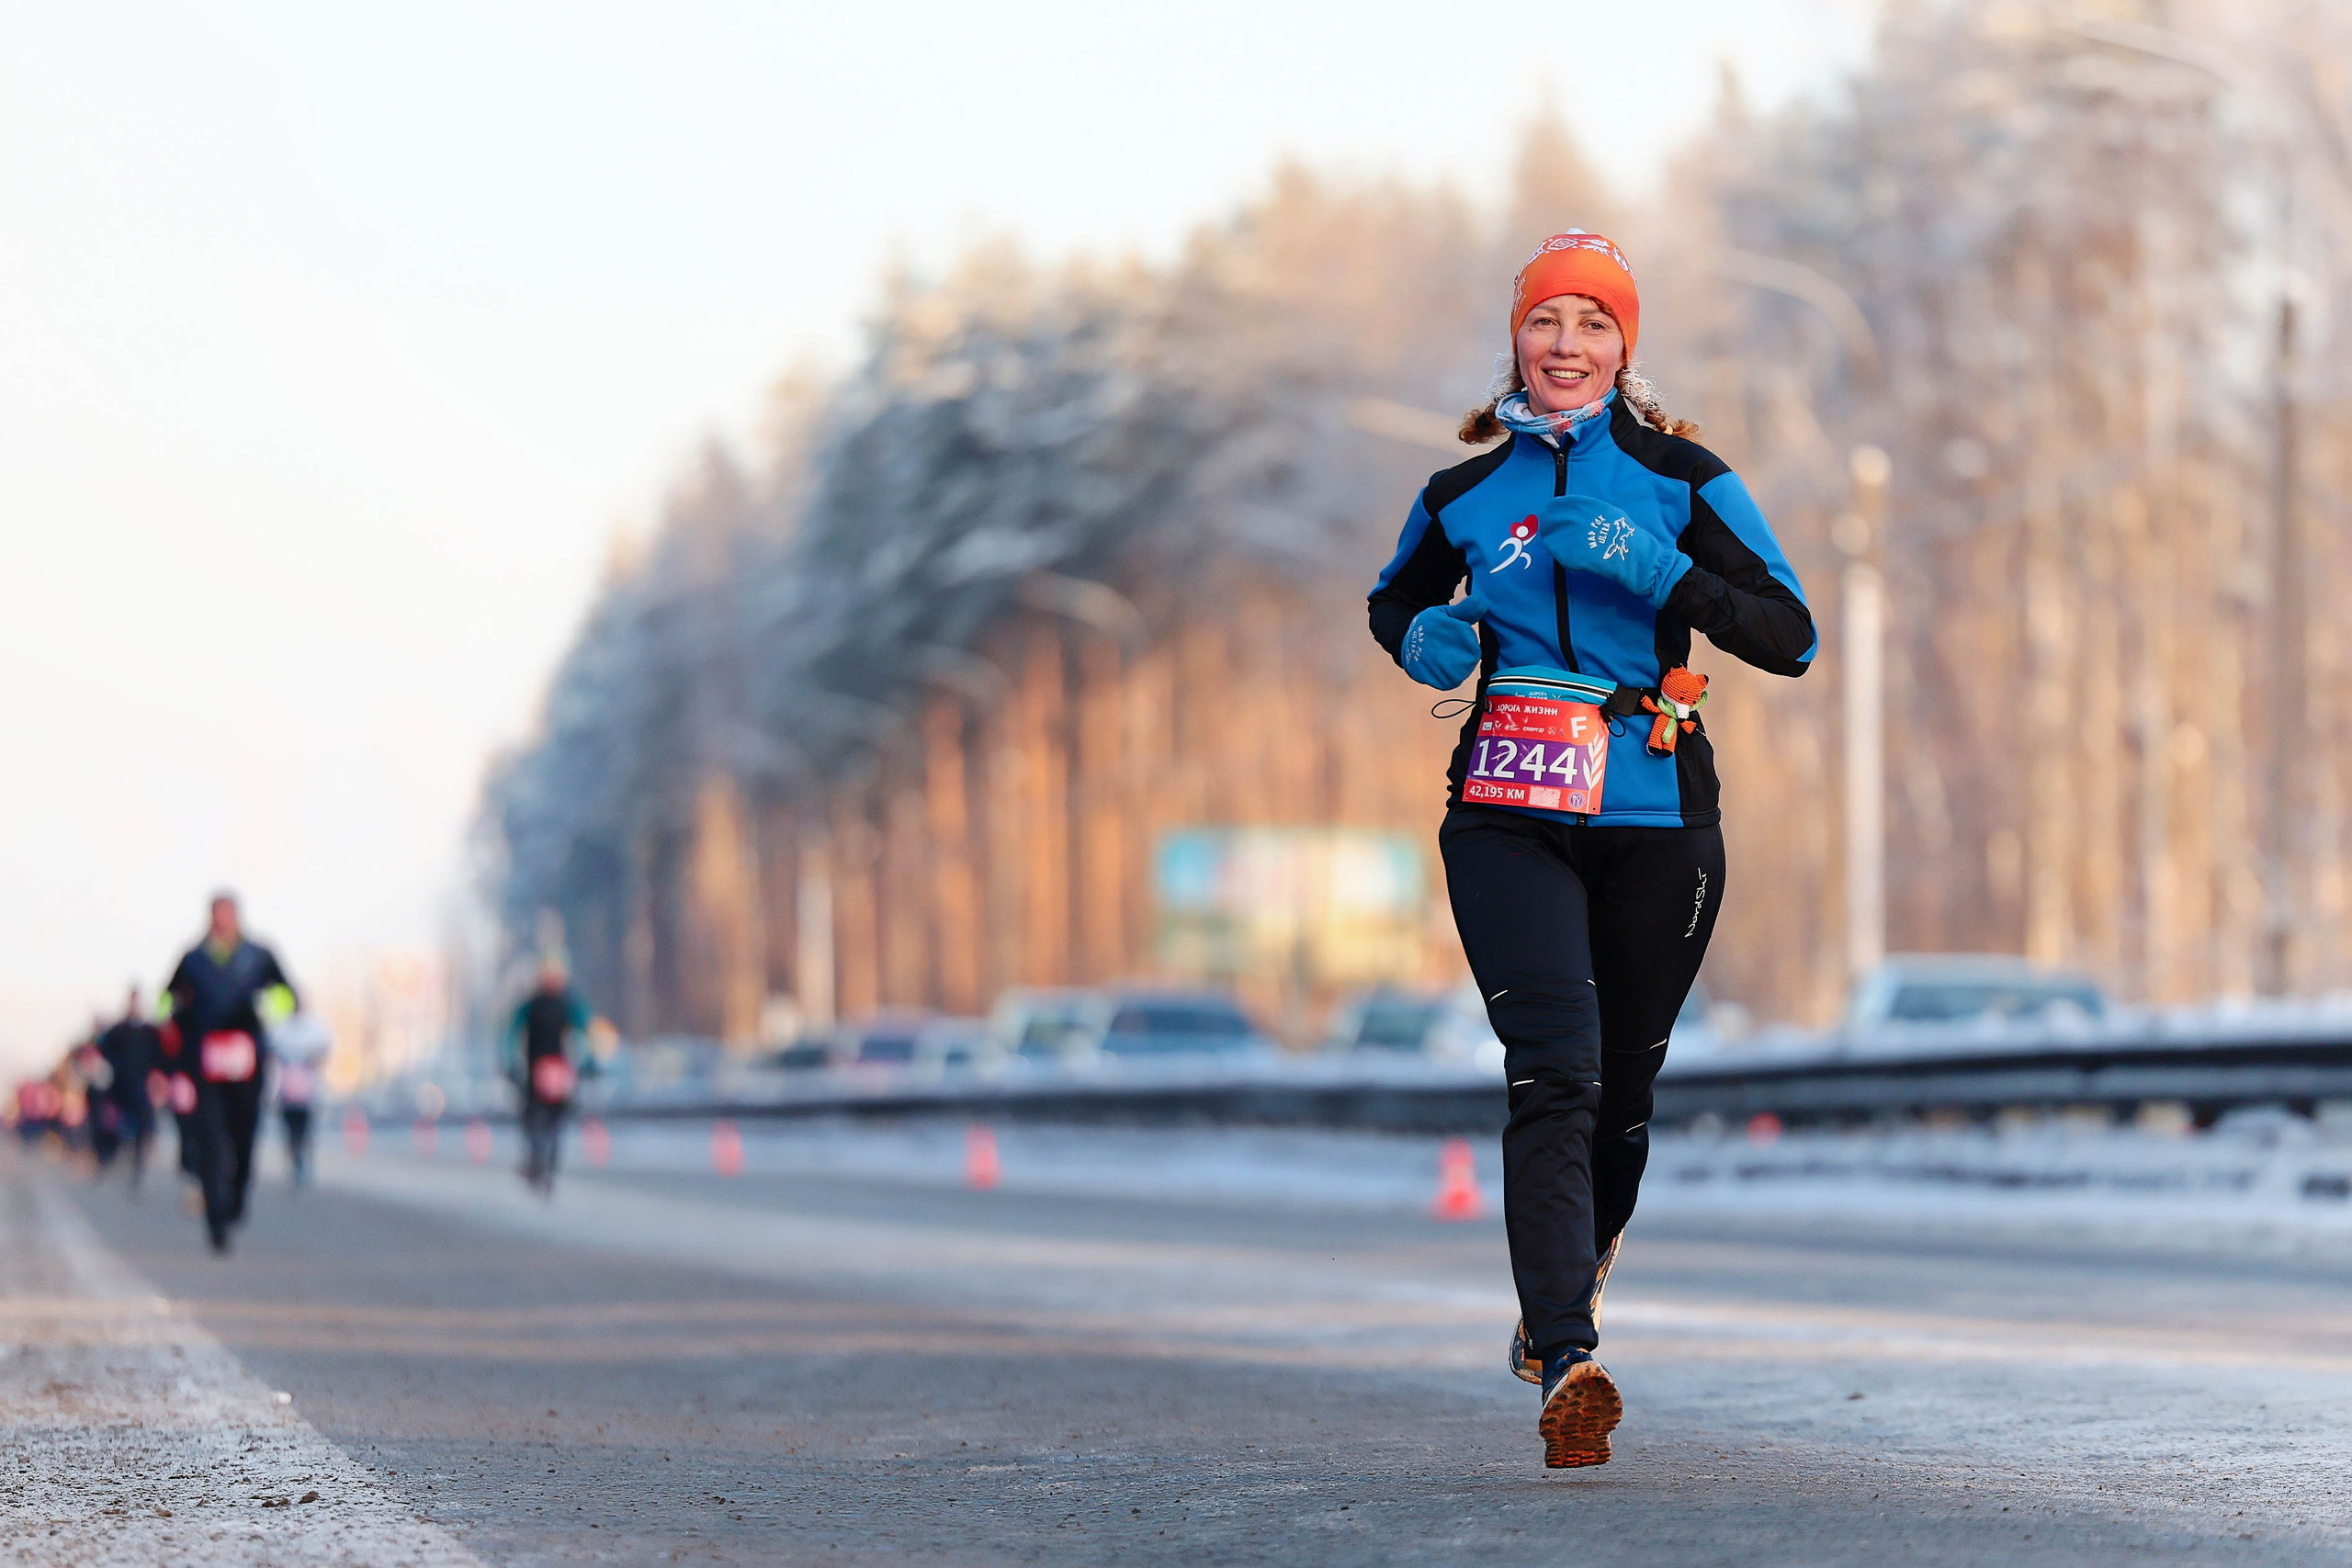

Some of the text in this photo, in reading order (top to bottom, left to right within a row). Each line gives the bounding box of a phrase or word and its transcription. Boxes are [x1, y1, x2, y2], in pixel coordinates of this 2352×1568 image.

[1588, 514, 1606, 549] MAD FOX
[1598, 523, 1611, 545] ULTRA
[1496, 704, 1559, 716] ДОРОГА ЖИЗНИ
[1570, 716, 1588, 739] F
[1473, 739, 1578, 784] 1244
[1469, 784, 1504, 799] 42,195
